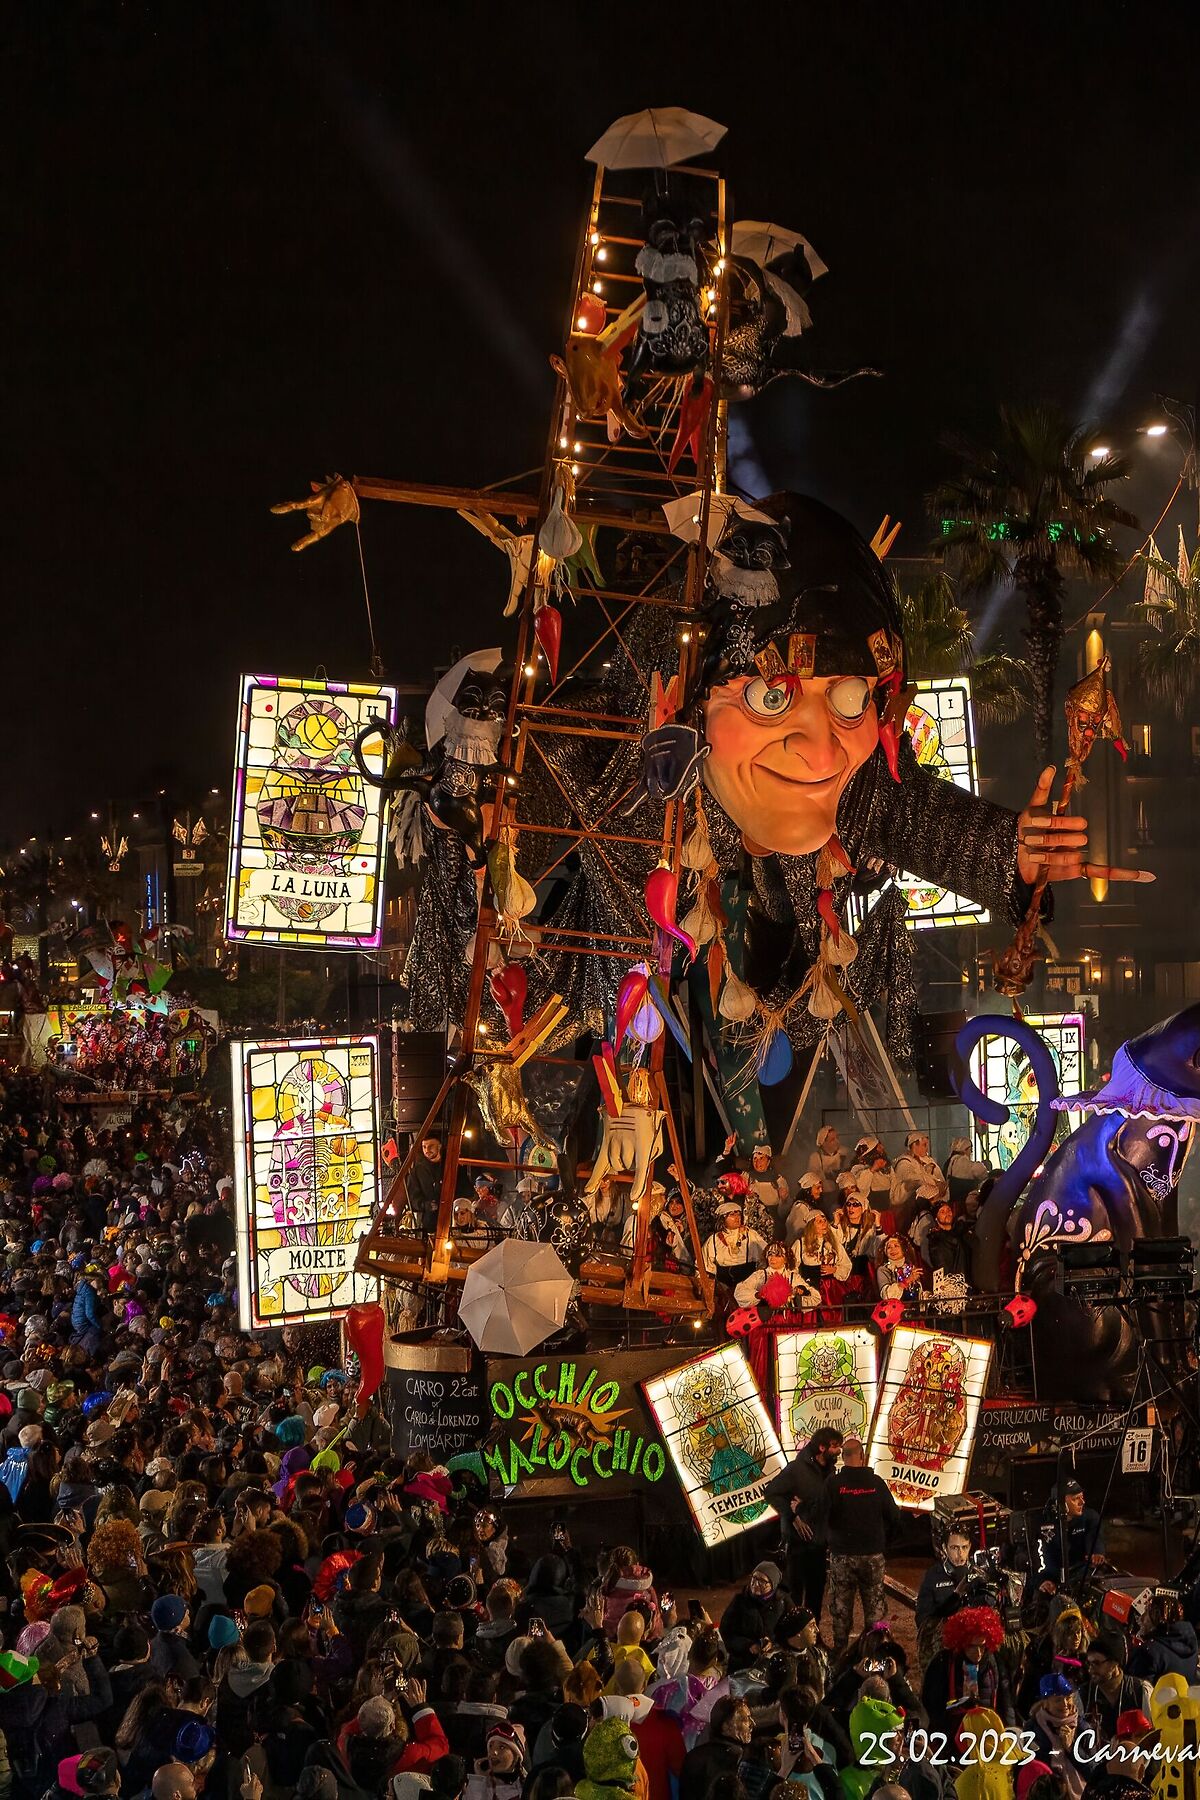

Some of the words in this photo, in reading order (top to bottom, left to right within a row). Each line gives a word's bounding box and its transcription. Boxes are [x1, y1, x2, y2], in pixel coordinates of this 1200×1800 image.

[271, 874, 295, 892] LA
[300, 876, 351, 898] LUNA
[1065, 1032, 1077, 1045] IX
[288, 1248, 347, 1271] MORTE
[405, 1377, 445, 1400] CARRO
[490, 1362, 620, 1420] OCCHIO
[814, 1397, 843, 1412] OCCHIO
[438, 1408, 480, 1428] LORENZO
[1054, 1415, 1085, 1432] CARLO
[992, 1431, 1032, 1449] CATEGORIA
[484, 1422, 666, 1487] MALOCCHIO
[1129, 1440, 1147, 1463] 16
[891, 1466, 940, 1488] DIAVOLO
